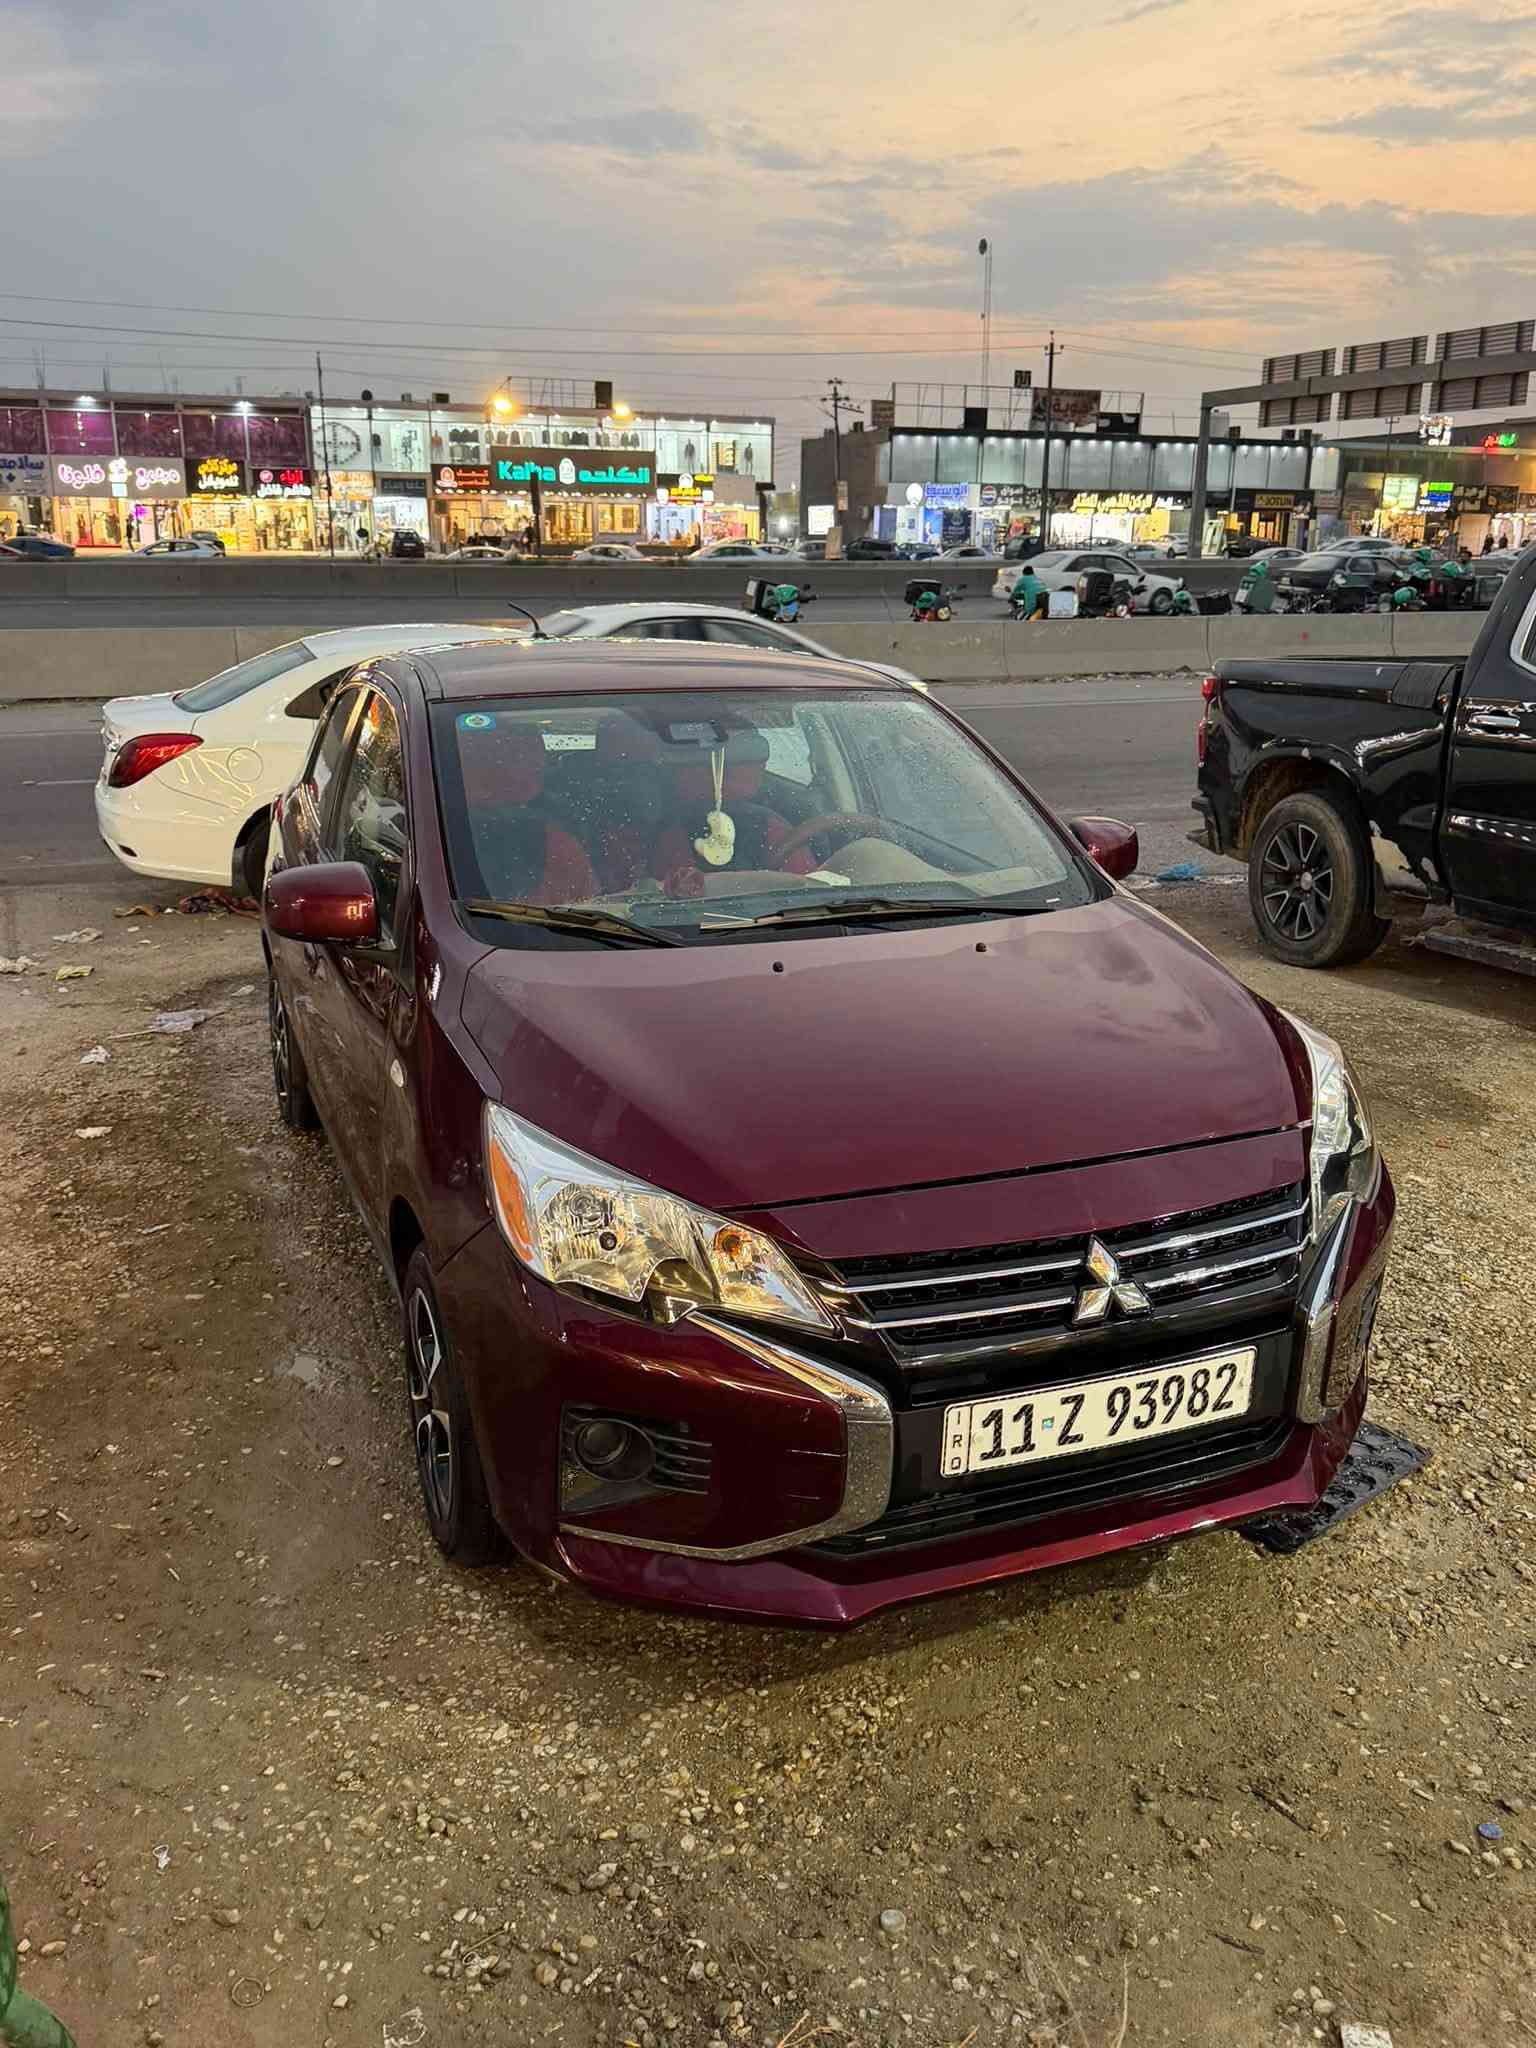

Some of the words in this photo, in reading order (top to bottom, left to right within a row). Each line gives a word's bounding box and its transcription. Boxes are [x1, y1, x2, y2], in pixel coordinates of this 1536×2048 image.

[497, 460, 556, 482] Kalha
[979, 1402, 1036, 1462] 11
[1057, 1393, 1085, 1447] Z
[1105, 1361, 1238, 1437] 93982
